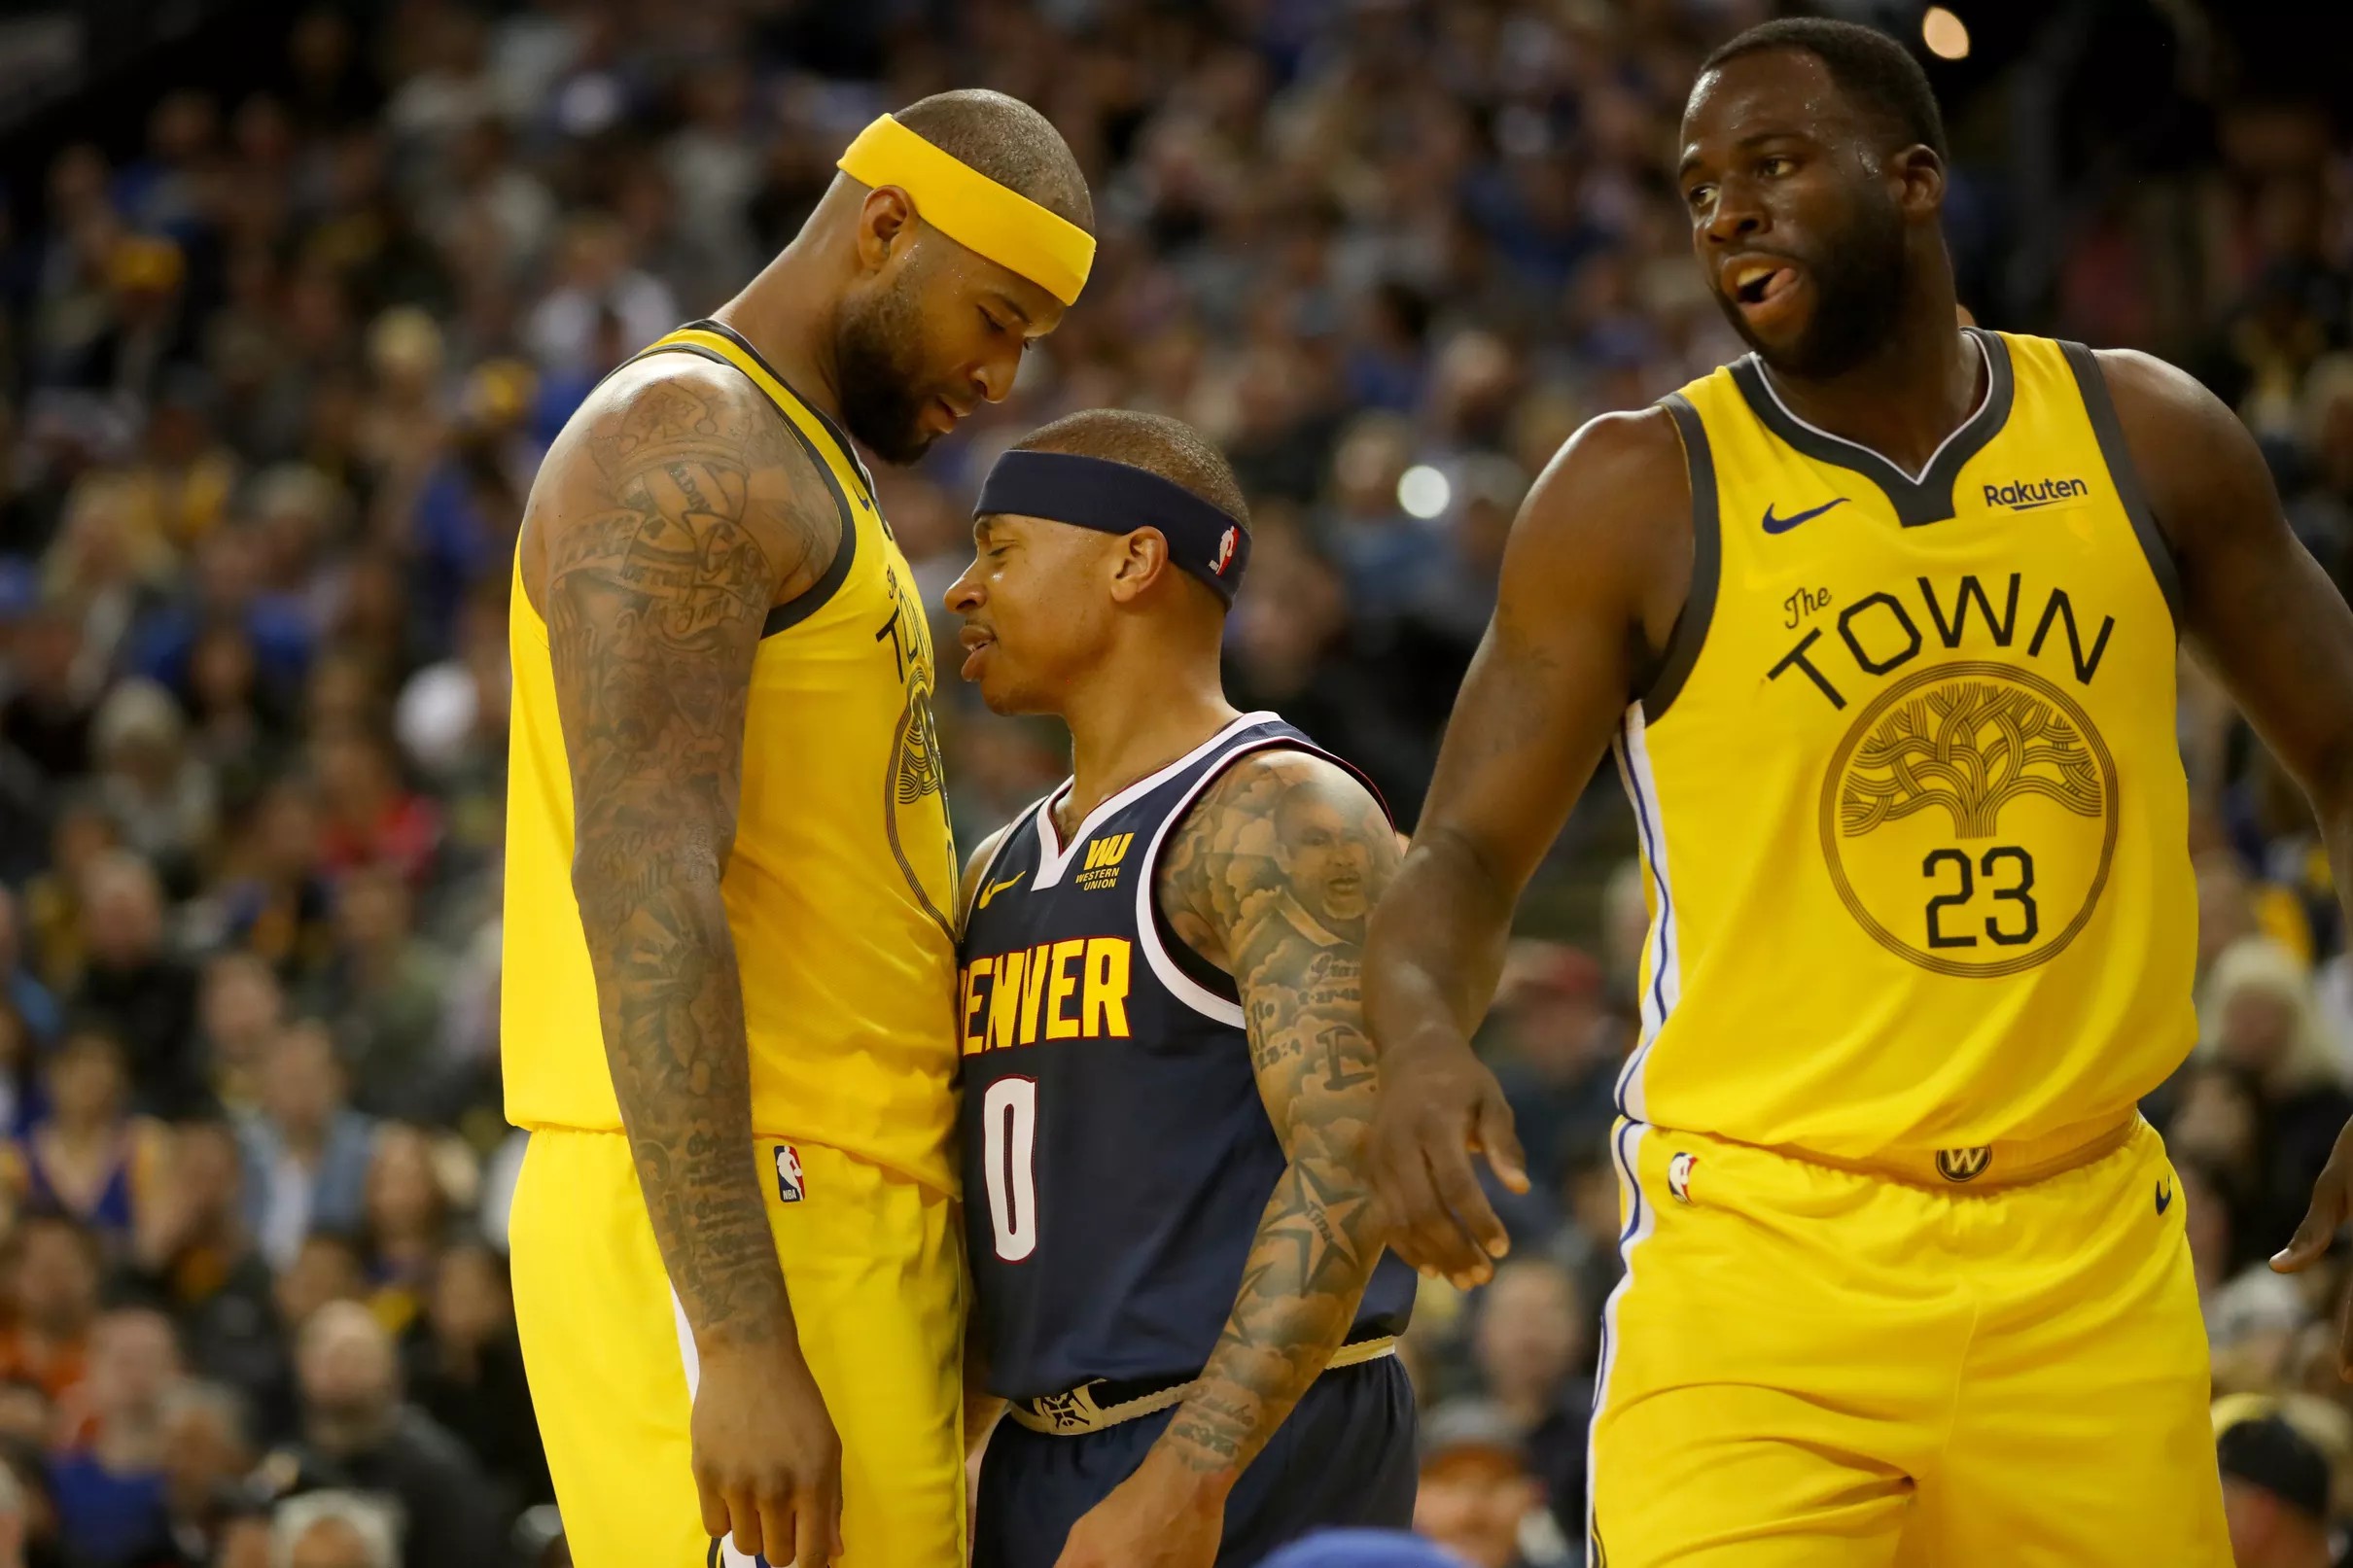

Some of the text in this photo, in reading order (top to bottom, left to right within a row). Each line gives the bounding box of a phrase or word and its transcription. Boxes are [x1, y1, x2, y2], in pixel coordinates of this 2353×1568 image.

[1983, 477, 2089, 508] Rakuten
[1784, 586, 1833, 630] The
[1767, 572, 2116, 712] TOWN
[1075, 867, 1120, 884] WESTERN
[1084, 878, 1117, 891] UNION
[1922, 846, 2039, 948] 23
[960, 934, 1134, 1059] ENVER
[982, 1073, 1039, 1265] 0
[783, 1189, 797, 1201] NBA
